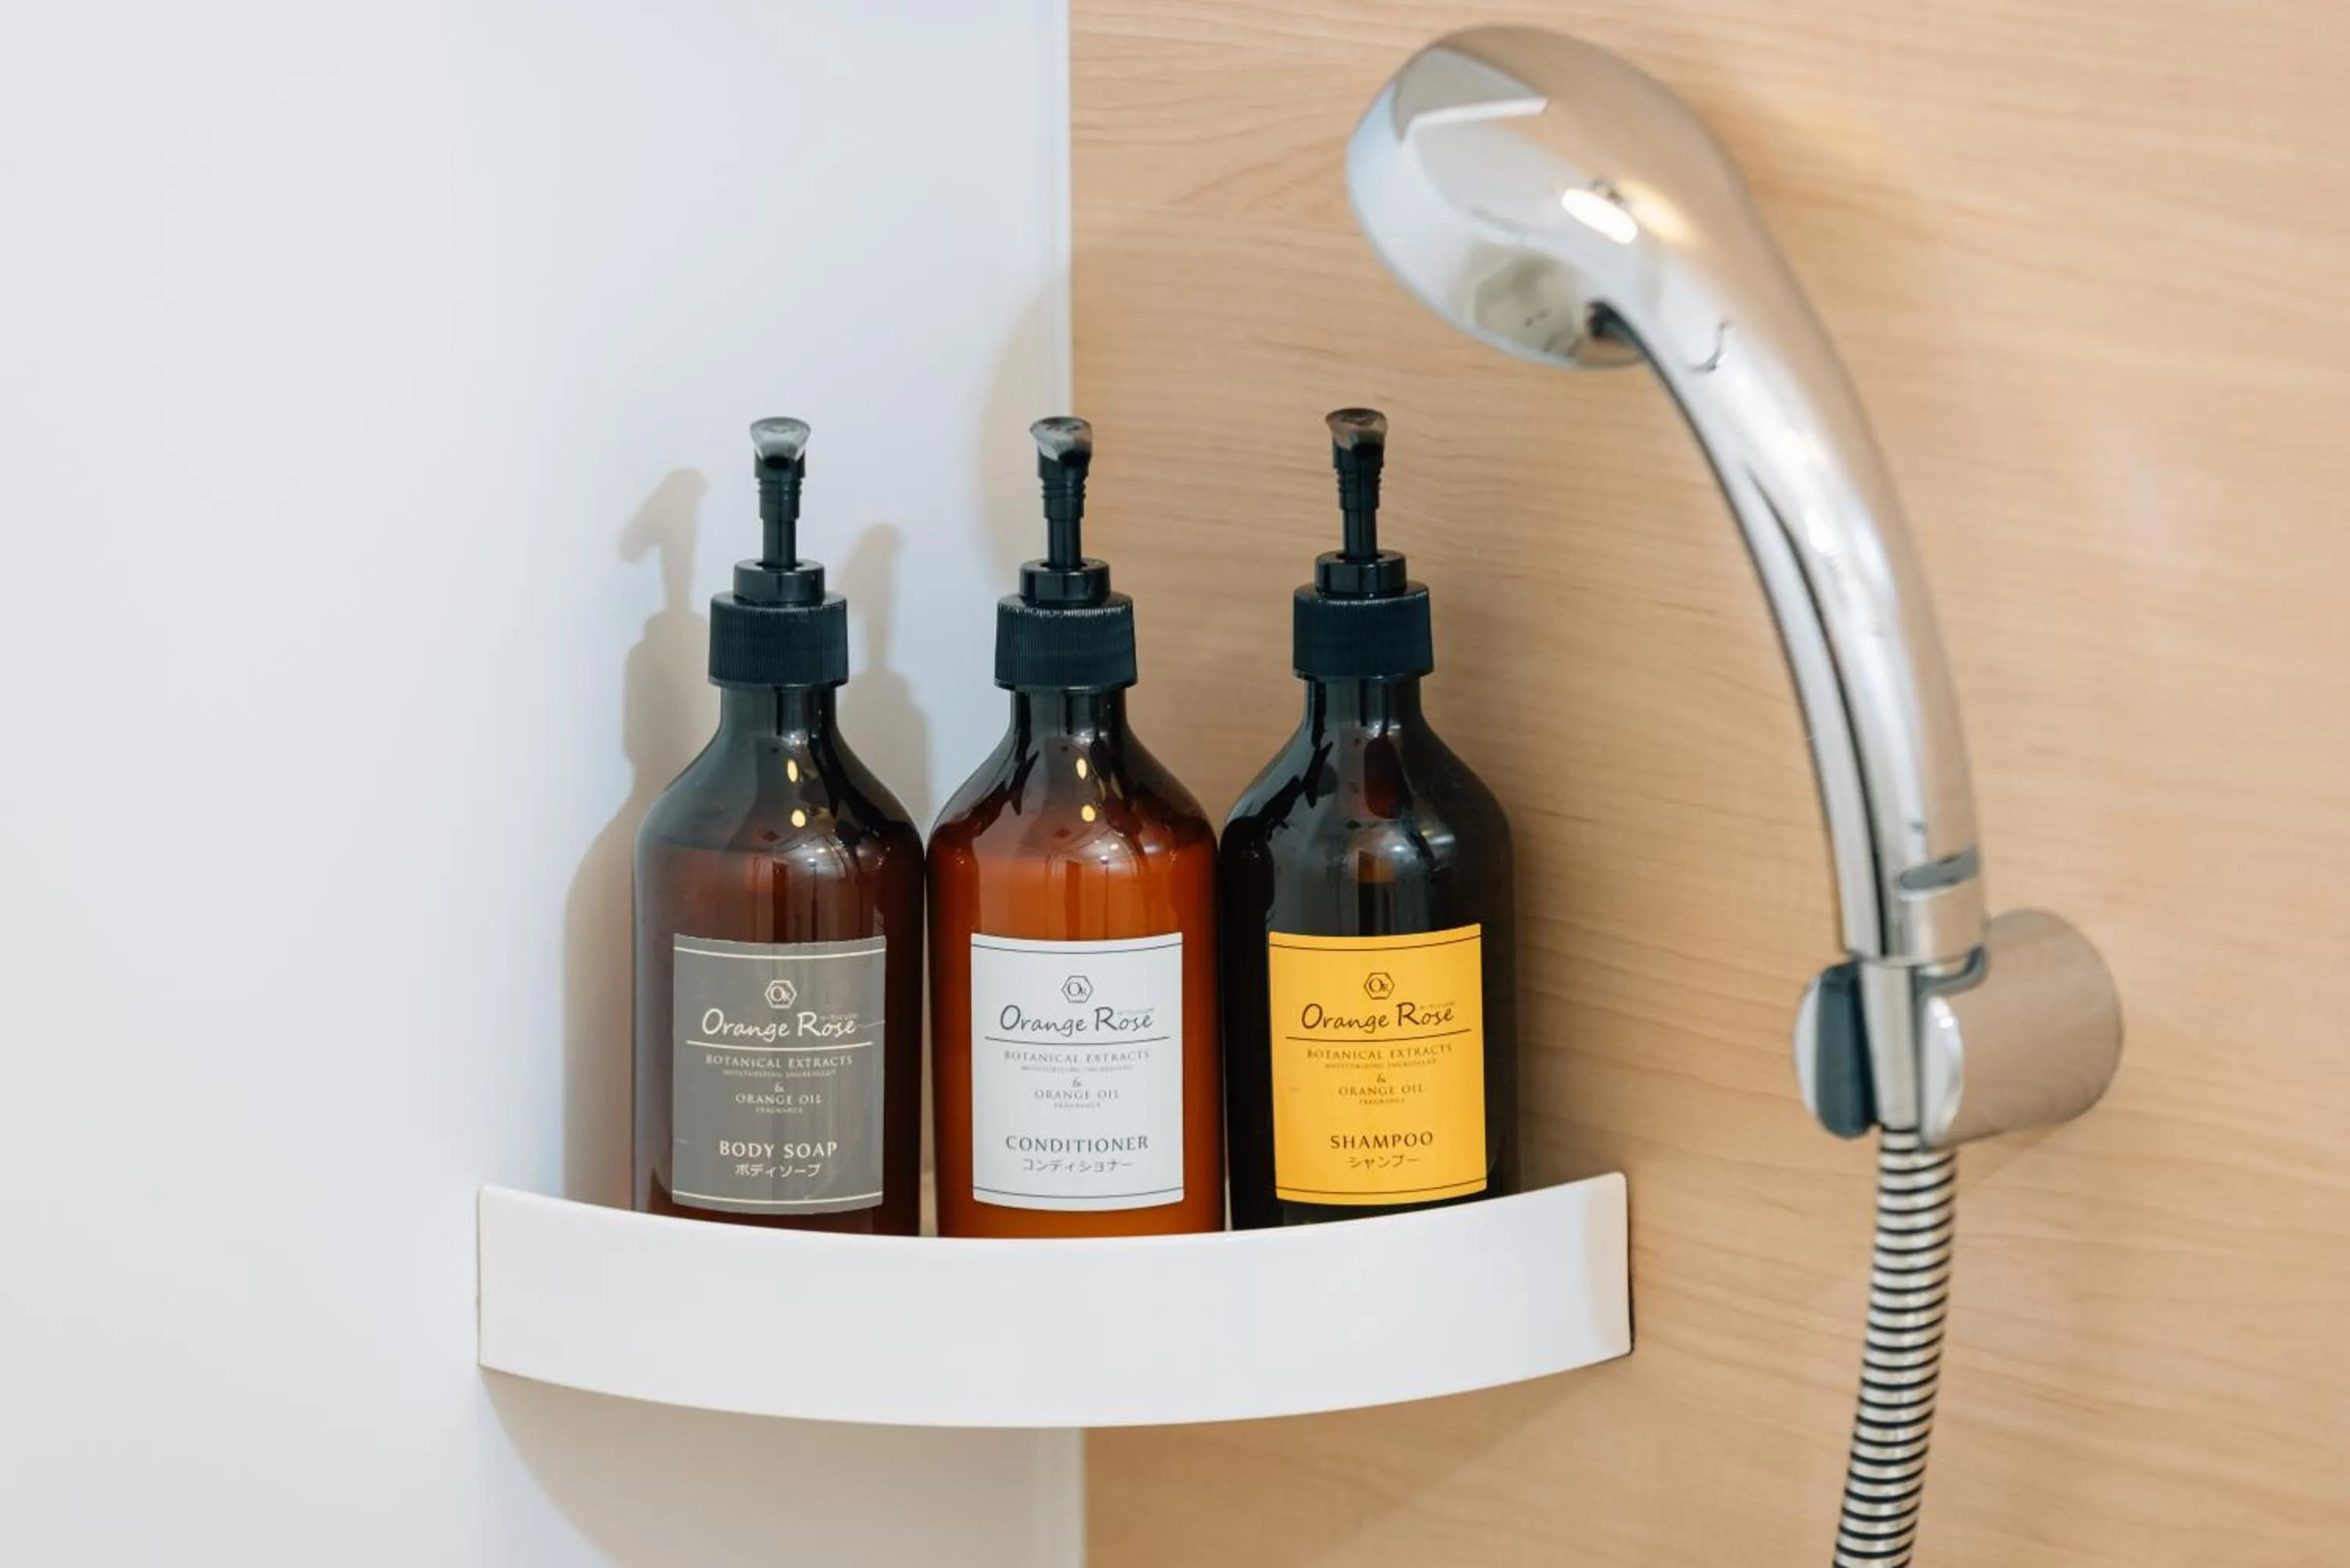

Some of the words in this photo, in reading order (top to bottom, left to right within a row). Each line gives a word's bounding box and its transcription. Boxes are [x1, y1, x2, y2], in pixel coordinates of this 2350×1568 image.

[702, 1008, 790, 1042] Orange
[797, 1011, 858, 1039] Rose
[1000, 1004, 1087, 1037] Orange
[1094, 1006, 1154, 1032] Rose
[1301, 1003, 1390, 1034] Orange
[1397, 1002, 1455, 1028] Rose
[1004, 1050, 1078, 1064] BOTANICAL
[1086, 1050, 1150, 1063] EXTRACTS
[1307, 1047, 1382, 1060] BOTANICAL
[1390, 1042, 1452, 1059] EXTRACTS
[706, 1054, 781, 1068] BOTANICAL
[788, 1055, 853, 1068] EXTRACTS
[1072, 1077, 1082, 1088] &
[1376, 1073, 1386, 1084] &
[774, 1082, 785, 1093] &
[1034, 1089, 1089, 1100] ORANGE
[1097, 1089, 1119, 1100] OIL
[1338, 1086, 1394, 1097] ORANGE
[1401, 1083, 1426, 1095] OIL
[735, 1094, 794, 1105] ORANGE
[799, 1094, 822, 1105] OIL
[1005, 1135, 1148, 1154] CONDITIONER
[1330, 1131, 1434, 1150] SHAMPOO
[719, 1140, 775, 1158] BODY
[783, 1141, 837, 1159] SOAP
[1021, 1158, 1133, 1173] コンディショナー
[1347, 1154, 1419, 1169] シャンプー
[735, 1163, 821, 1178] ボディソープ
